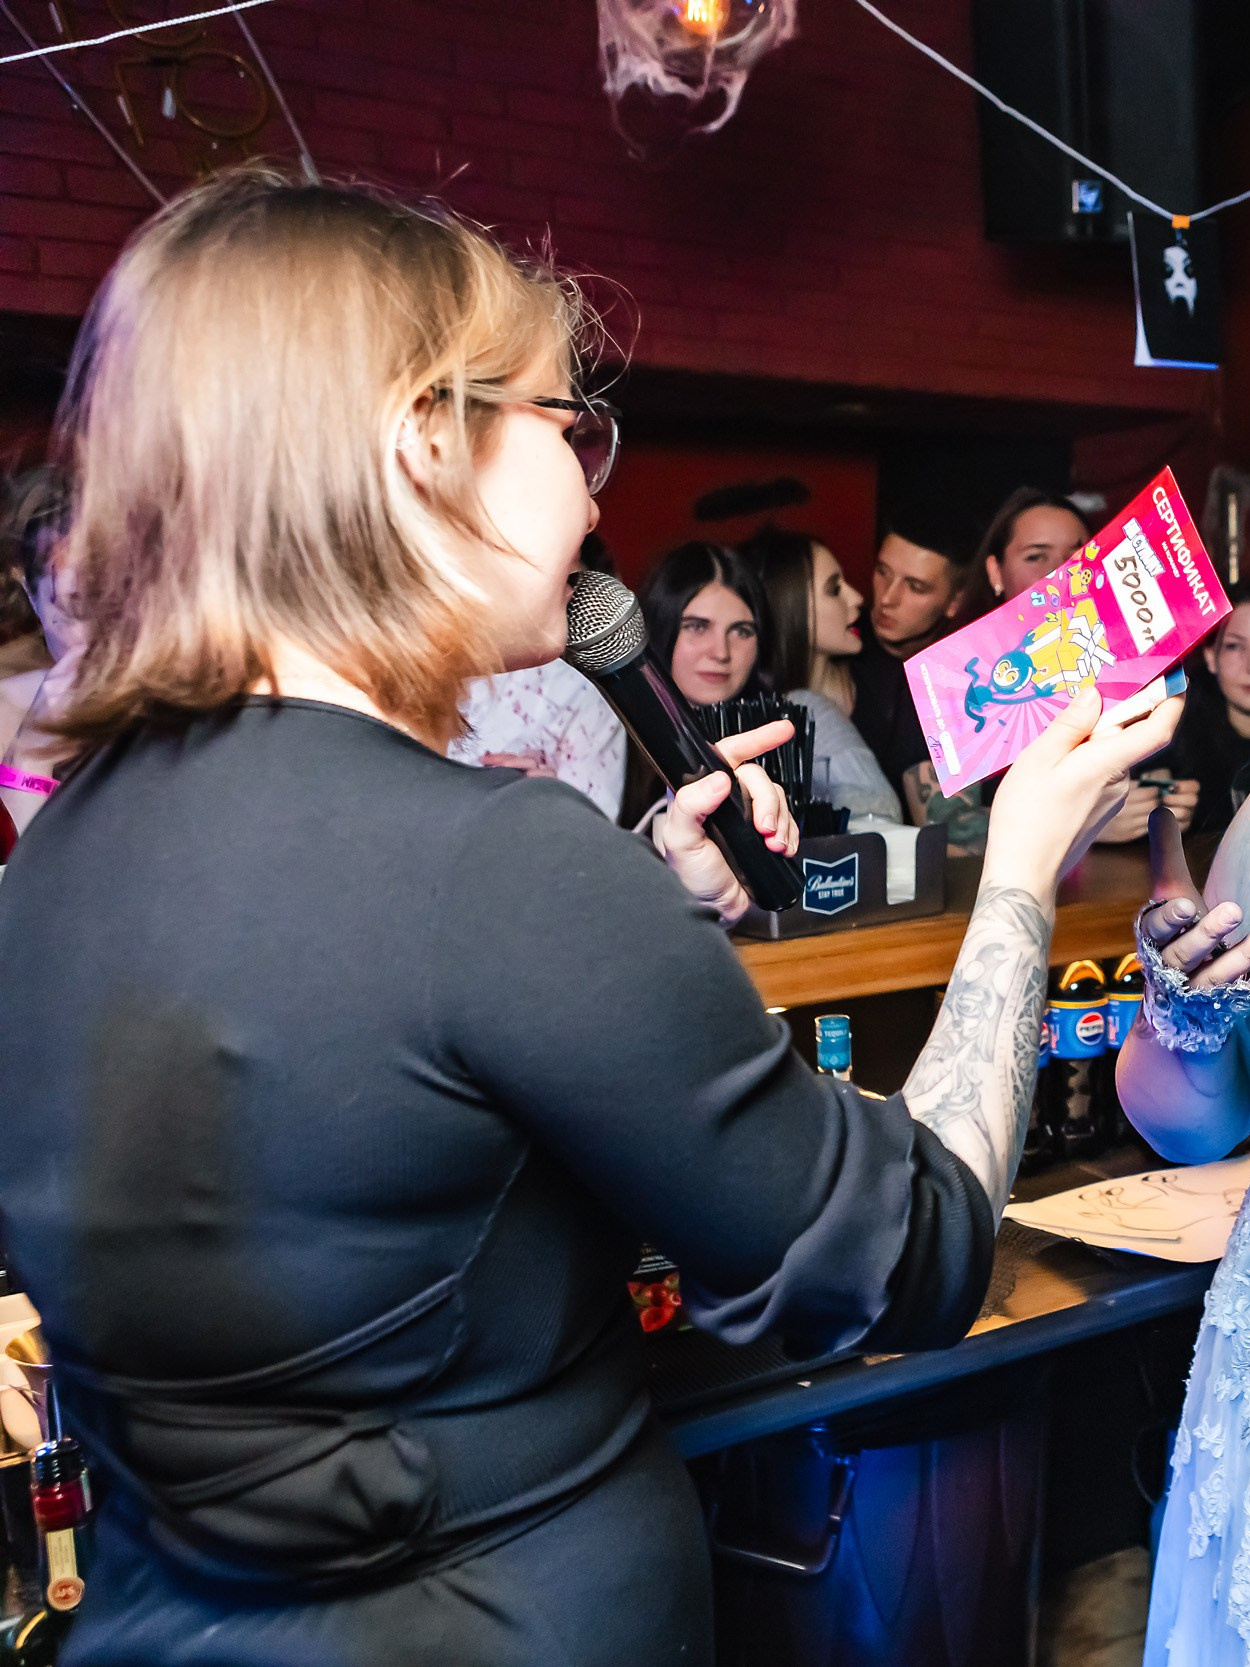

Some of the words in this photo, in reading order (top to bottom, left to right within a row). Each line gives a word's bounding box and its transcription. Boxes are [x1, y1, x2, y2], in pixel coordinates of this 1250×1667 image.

[1152, 486, 1216, 616] СЕРТИФИКАТ
[1113, 555, 1153, 624] 5000
[920, 663, 941, 718] ИСПОЛЬЗОВАТЬ
